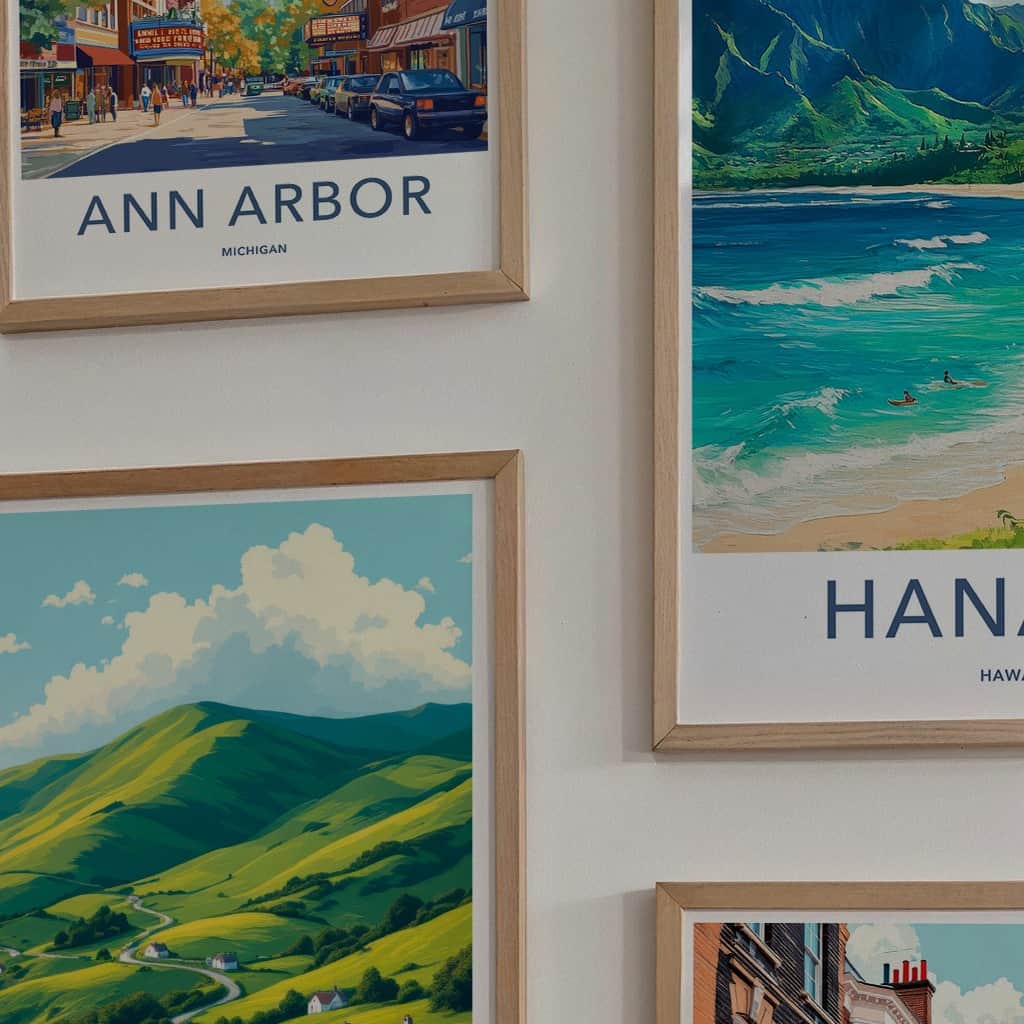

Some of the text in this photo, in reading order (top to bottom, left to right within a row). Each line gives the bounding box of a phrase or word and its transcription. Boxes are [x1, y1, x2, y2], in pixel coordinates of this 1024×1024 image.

[77, 175, 432, 236] ANN ARBOR
[221, 243, 287, 257] MICHIGAN
[826, 577, 1024, 639] HAN
[980, 668, 1024, 682] HAW
